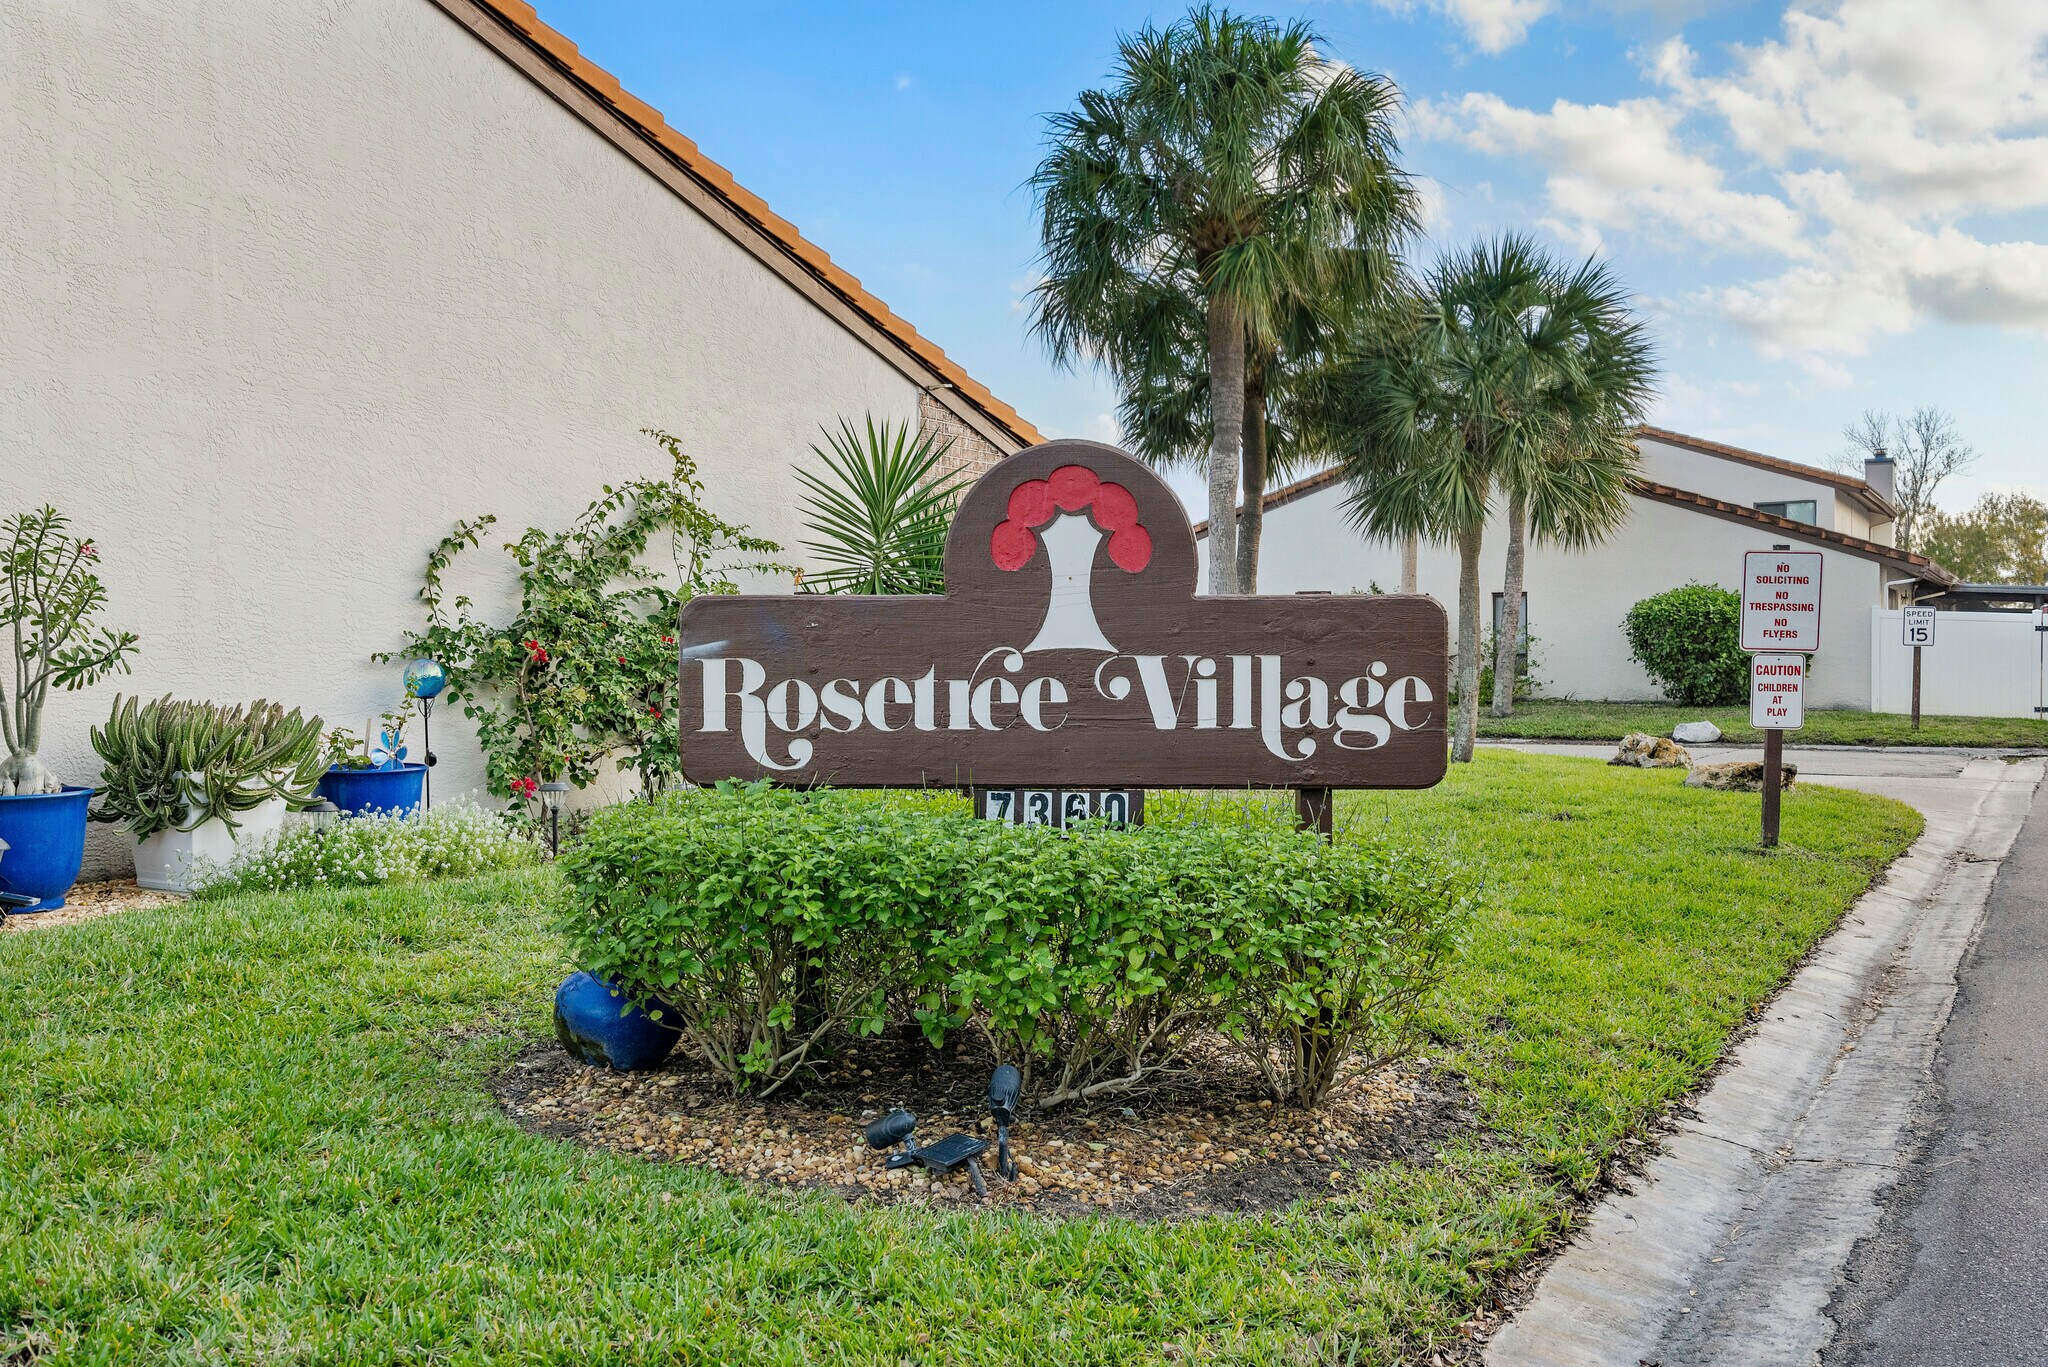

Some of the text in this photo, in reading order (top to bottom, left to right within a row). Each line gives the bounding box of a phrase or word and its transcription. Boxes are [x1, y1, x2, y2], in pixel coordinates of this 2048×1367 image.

[1776, 564, 1790, 573] NO
[1756, 575, 1809, 585] SOLICITING
[1775, 591, 1789, 600] NO
[1749, 602, 1814, 612] TRESPASSING
[1906, 610, 1933, 618] SPEED
[1774, 618, 1788, 627] NO
[1763, 629, 1798, 639] FLYERS
[1910, 628, 1928, 642] 15
[1755, 664, 1801, 677] CAUTION
[1757, 683, 1799, 693] CHILDREN
[1772, 695, 1783, 705] AT
[694, 646, 1434, 771] Rosetree Village
[1766, 707, 1788, 717] PLAY
[990, 792, 1126, 832] 7360
